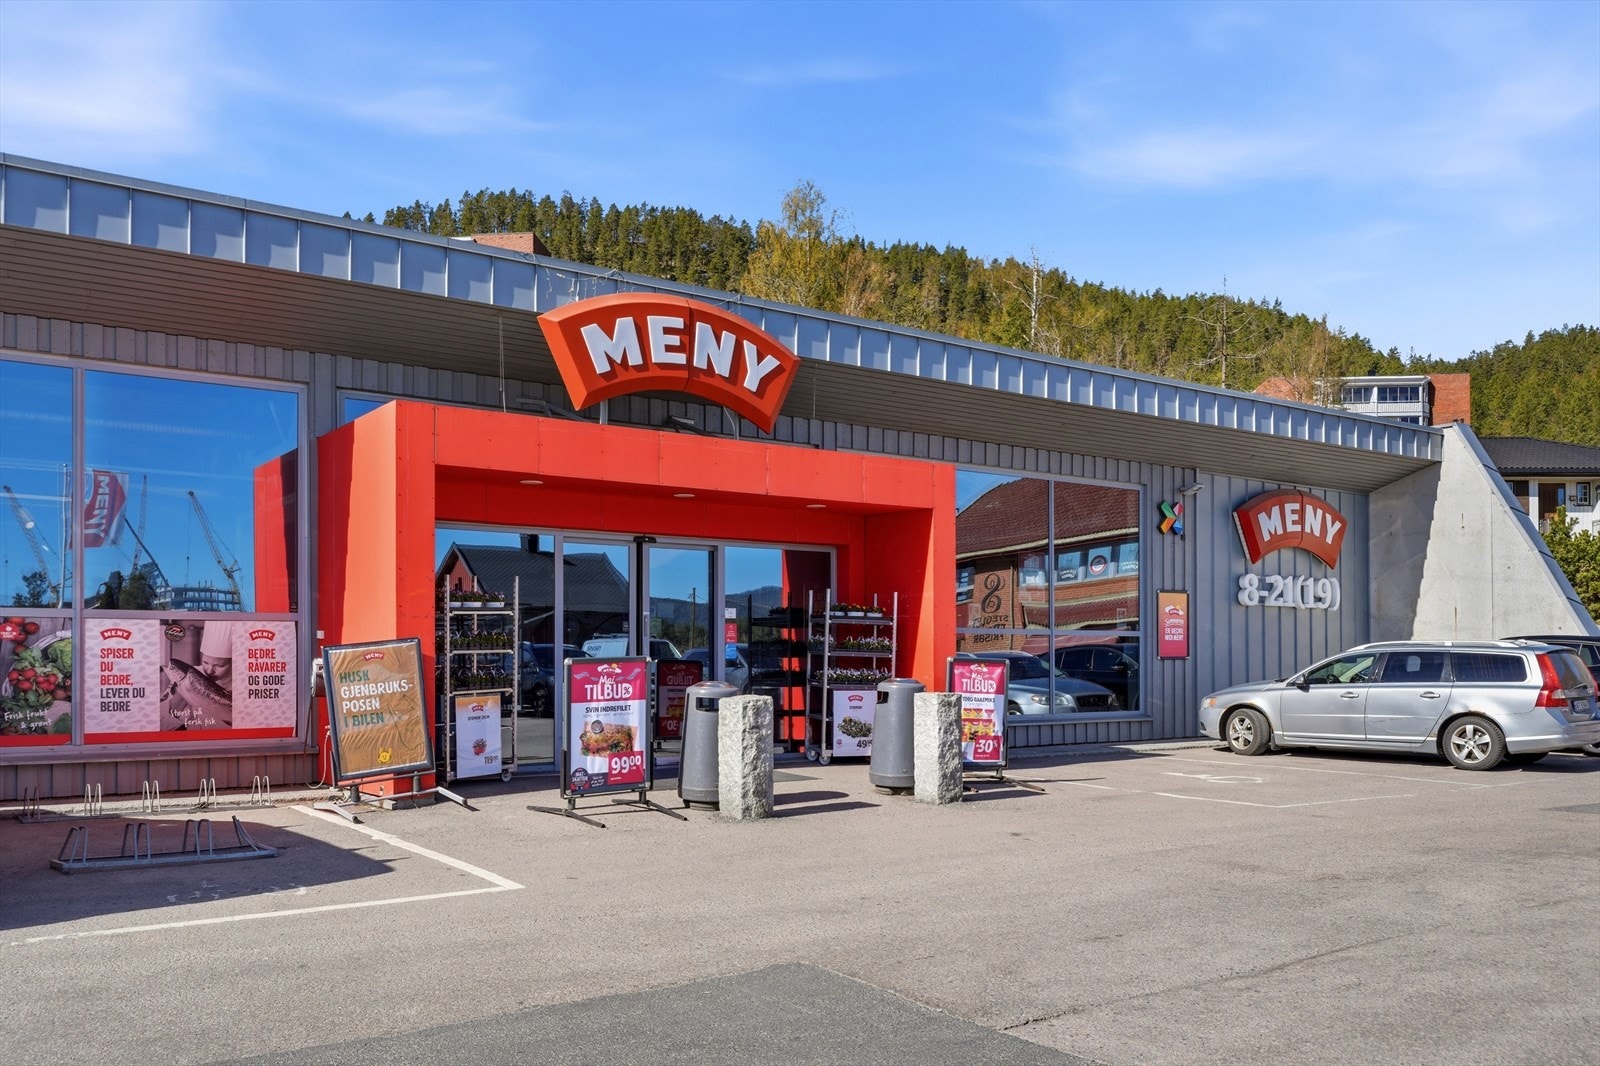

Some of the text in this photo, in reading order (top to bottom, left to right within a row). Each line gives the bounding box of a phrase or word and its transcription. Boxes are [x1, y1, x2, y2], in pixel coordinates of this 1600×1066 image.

[580, 315, 781, 393] MENY
[84, 475, 110, 538] MENY
[1257, 503, 1342, 545] MENY
[1238, 573, 1341, 611] 8-21(19)
[103, 630, 129, 638] MENY
[100, 648, 134, 659] SPISER
[248, 648, 276, 659] BEDRE
[364, 652, 383, 660] MENY
[100, 661, 114, 672] DU
[248, 659, 287, 672] RÅVARER
[100, 674, 134, 686] BEDRE,
[248, 675, 285, 686] OG GODE
[339, 669, 370, 683] HUSK
[598, 675, 616, 685] Mai
[340, 679, 413, 699] GJENBRUKS-
[585, 683, 633, 700] TILBUD
[962, 679, 996, 693] TILBUD
[100, 688, 145, 698] LEVER DU
[248, 688, 280, 699] PRISER
[100, 701, 131, 712] BEDRE
[342, 698, 380, 713] POSEN
[600, 704, 632, 712] INDREFILET
[4, 709, 49, 721] Frisk frukt
[352, 711, 385, 727] BILEN
[29, 720, 52, 731] grønt
